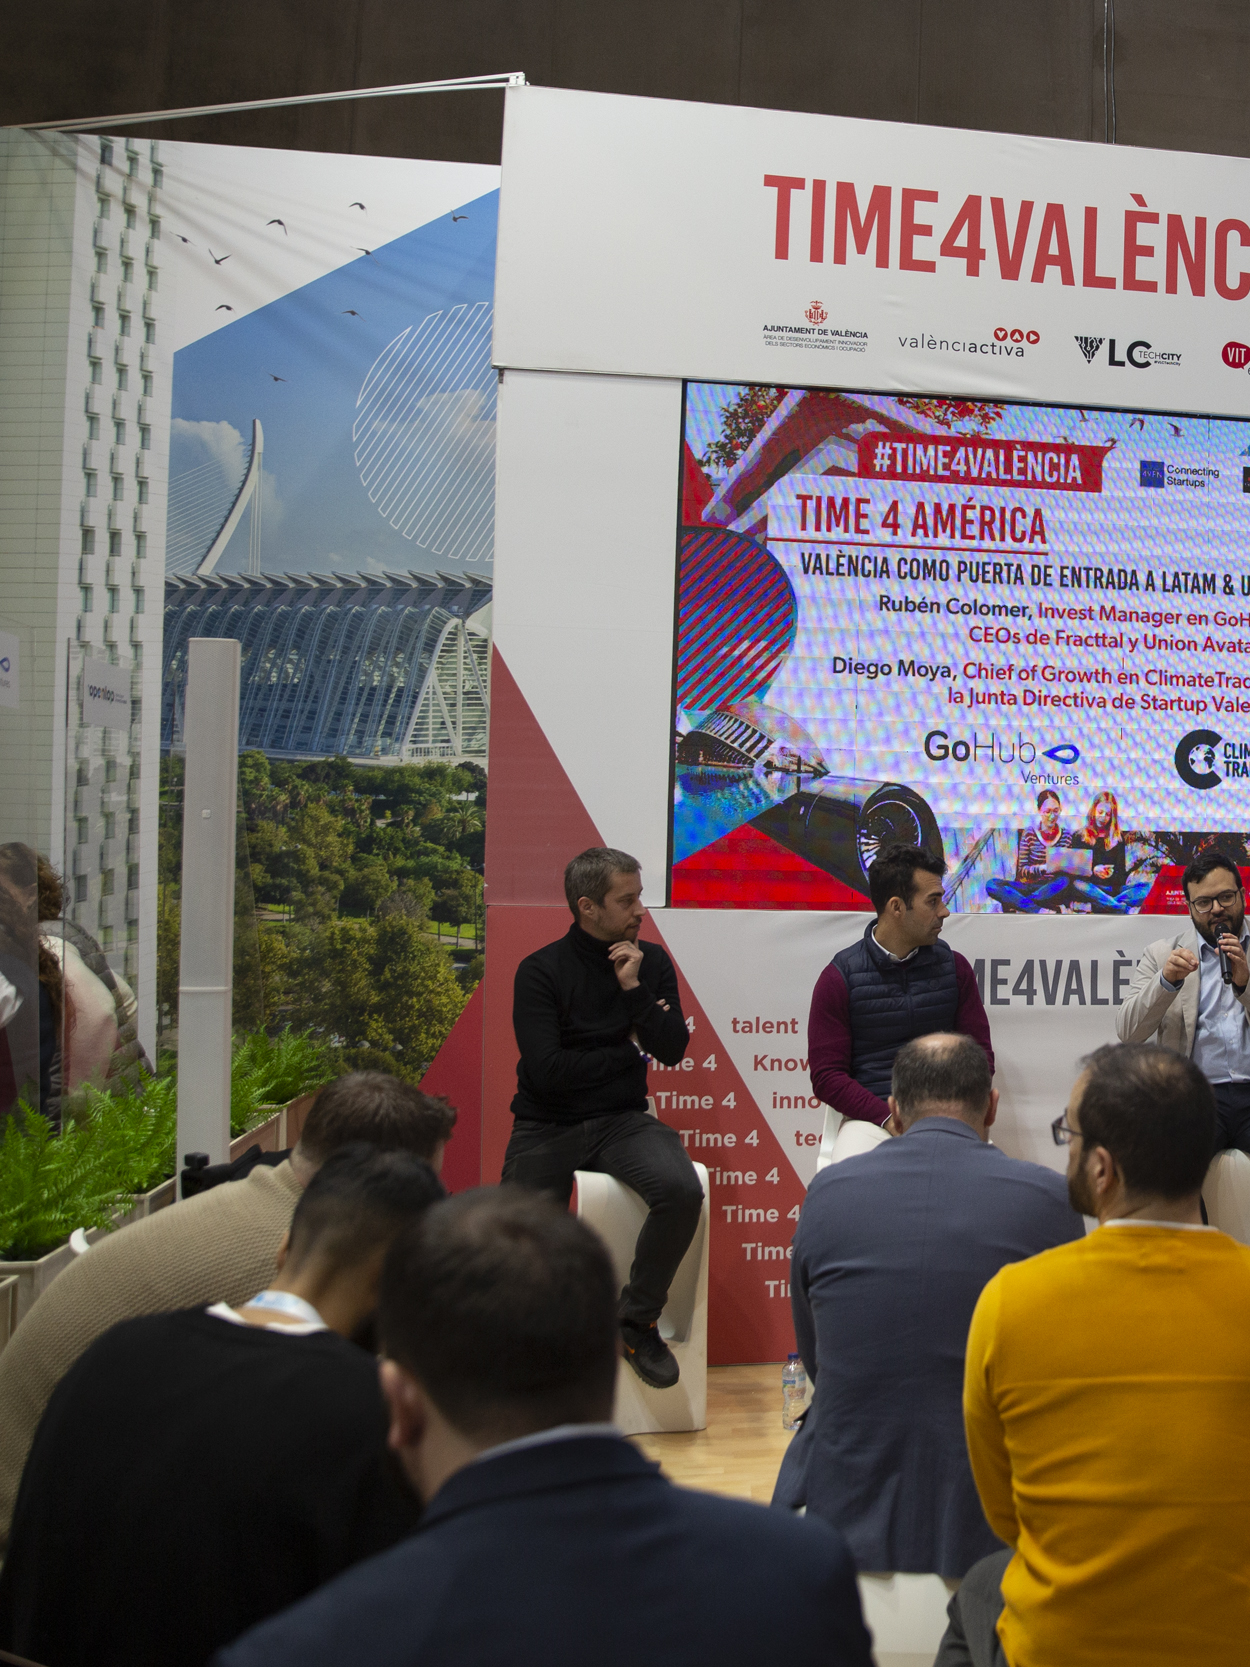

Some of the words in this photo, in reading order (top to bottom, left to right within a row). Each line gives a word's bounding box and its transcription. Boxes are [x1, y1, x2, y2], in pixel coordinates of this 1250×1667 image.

[763, 324, 816, 335] AJUNTAMENT
[818, 328, 828, 336] DE
[830, 329, 868, 339] VALÈNCIA
[1227, 347, 1247, 364] VIT
[873, 441, 1082, 484] #TIME4VALÈNCIA
[1166, 464, 1220, 479] Connecting
[1166, 477, 1205, 488] Startups
[796, 494, 870, 535] TIME
[881, 500, 900, 536] 4
[911, 497, 1047, 545] AMÉRICA
[800, 549, 890, 580] VALÈNCIA
[897, 557, 950, 582] COMO
[957, 561, 1025, 586] PUERTA
[1031, 564, 1052, 588] DE
[1059, 565, 1139, 592] ENTRADA
[1145, 570, 1155, 592] A
[1162, 570, 1216, 595] LATAM
[1222, 573, 1235, 595] &
[879, 594, 941, 615] Rubén
[946, 598, 1033, 621] Colomer,
[1038, 602, 1095, 621] Invest
[1099, 605, 1182, 626] Manager
[1187, 613, 1209, 626] en
[969, 625, 1021, 645] CEOs
[1026, 626, 1051, 645] de
[1055, 629, 1124, 650] Fracttal
[1128, 638, 1139, 652] y
[1143, 634, 1198, 652] Union
[832, 656, 892, 680] Diego
[897, 659, 957, 681] Moya,
[963, 661, 1014, 681] Chief
[1018, 664, 1038, 681] of
[1041, 665, 1112, 686] Growth
[1118, 672, 1139, 685] en
[948, 687, 964, 704] la
[967, 689, 1018, 707] Junta
[1022, 690, 1107, 709] Directiva
[1111, 693, 1136, 709] de
[1140, 695, 1208, 716] Startup
[924, 730, 1037, 764] GoHub
[1021, 770, 1079, 785] Ventures
[732, 1016, 799, 1034] talent
[702, 1054, 718, 1071] 4
[753, 1054, 809, 1071] Know
[656, 1091, 714, 1109] Time
[721, 1092, 737, 1109] 4
[772, 1091, 822, 1109] inno
[679, 1129, 737, 1147] Time
[744, 1129, 760, 1147] 4
[765, 1167, 780, 1184] 4
[722, 1205, 779, 1223] Time
[787, 1204, 800, 1222] 4
[765, 1279, 791, 1298] Ti
